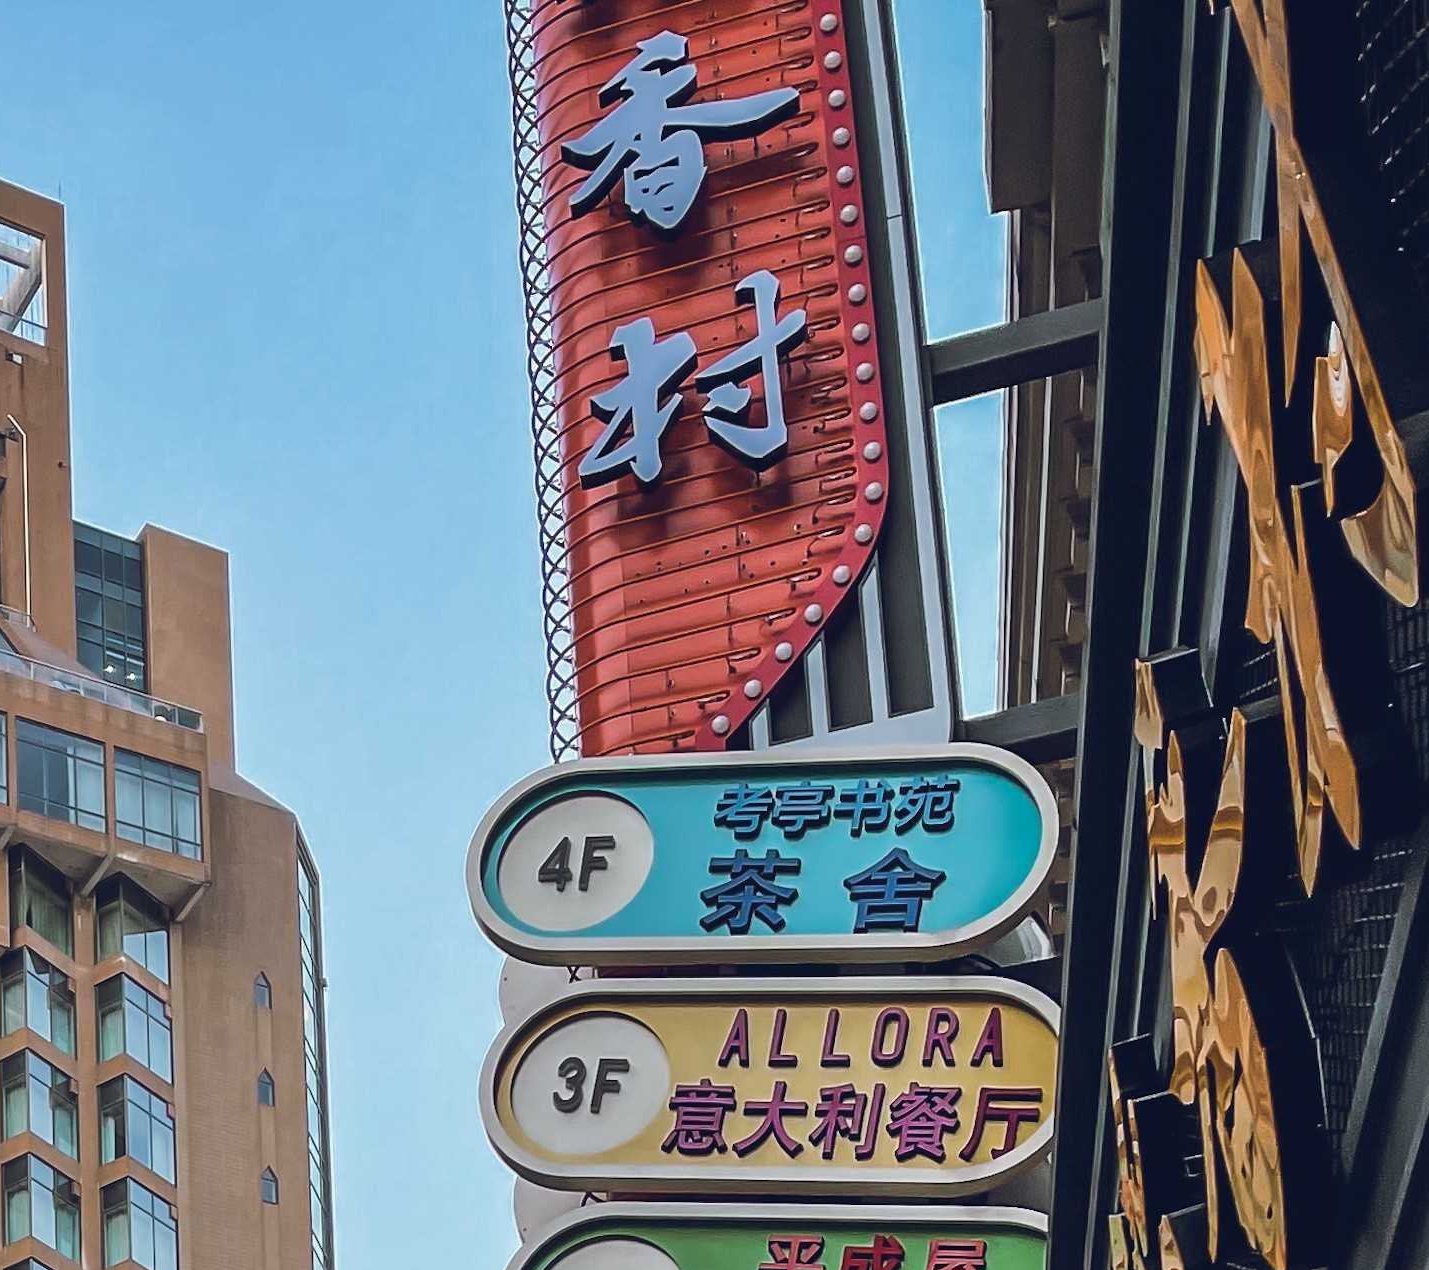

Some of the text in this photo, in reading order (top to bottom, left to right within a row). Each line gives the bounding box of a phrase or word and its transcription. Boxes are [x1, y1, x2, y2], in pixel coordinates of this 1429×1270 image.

[712, 774, 961, 840] 考亭书苑
[537, 834, 617, 893] 4F
[717, 1005, 1005, 1069] ALLORA
[551, 1056, 632, 1115] 3F
[660, 1079, 1044, 1165] 意大利餐厅
